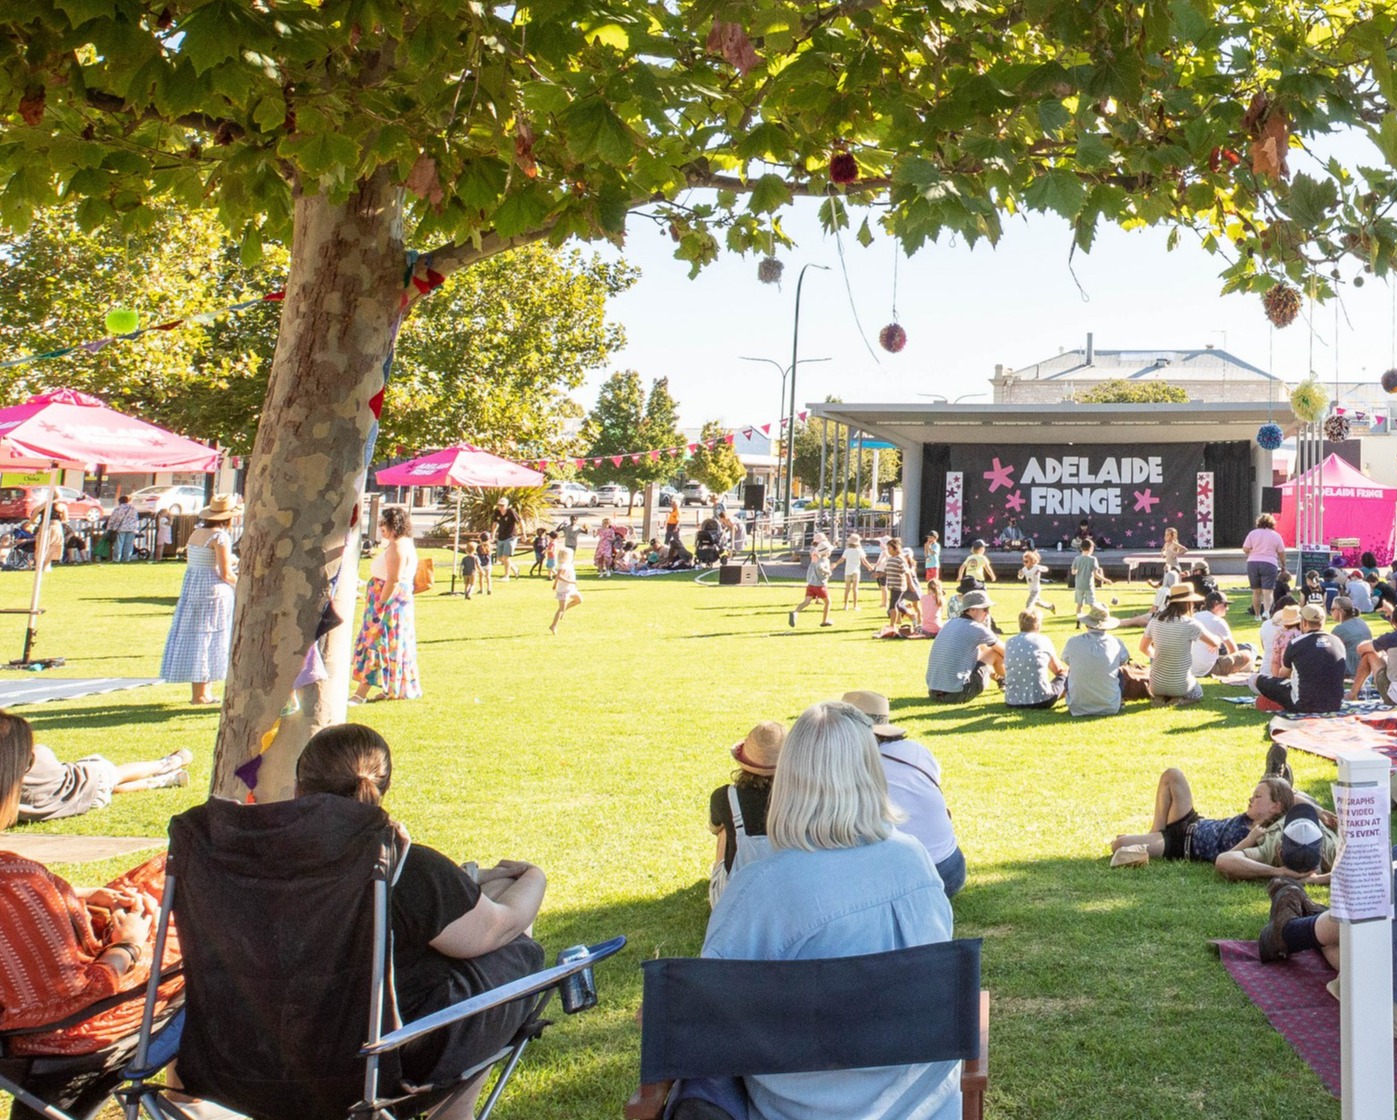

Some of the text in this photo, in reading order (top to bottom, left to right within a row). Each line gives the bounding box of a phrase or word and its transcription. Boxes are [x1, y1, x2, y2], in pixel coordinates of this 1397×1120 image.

[1020, 456, 1163, 484] ADELAIDE
[1356, 489, 1384, 498] FRINGE
[1031, 487, 1122, 514] FRINGE
[1351, 808, 1374, 816] VIDEO
[1346, 819, 1370, 827] TAKEN
[1371, 818, 1381, 826] AT
[1356, 829, 1381, 838] EVENT.
